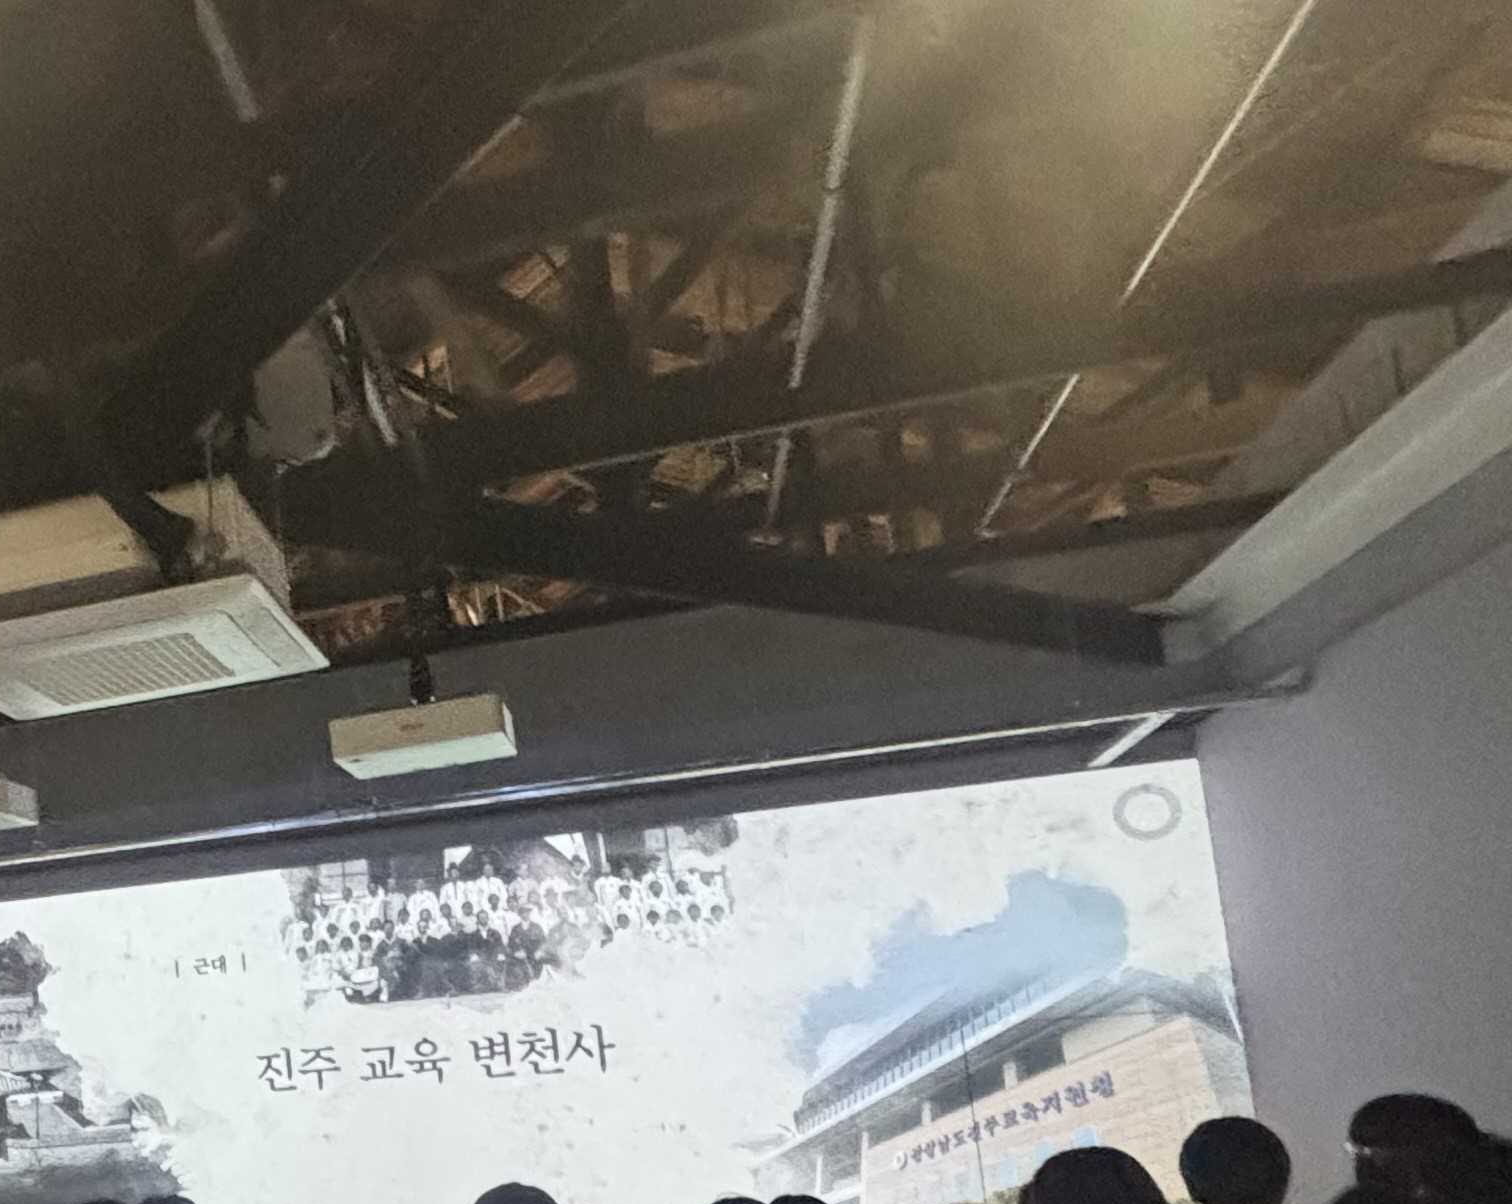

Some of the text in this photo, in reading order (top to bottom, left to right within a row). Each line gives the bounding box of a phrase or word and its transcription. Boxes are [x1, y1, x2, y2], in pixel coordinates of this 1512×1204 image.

[192, 953, 227, 976] 근대
[256, 1023, 616, 1092] 진주 교육 변천사
